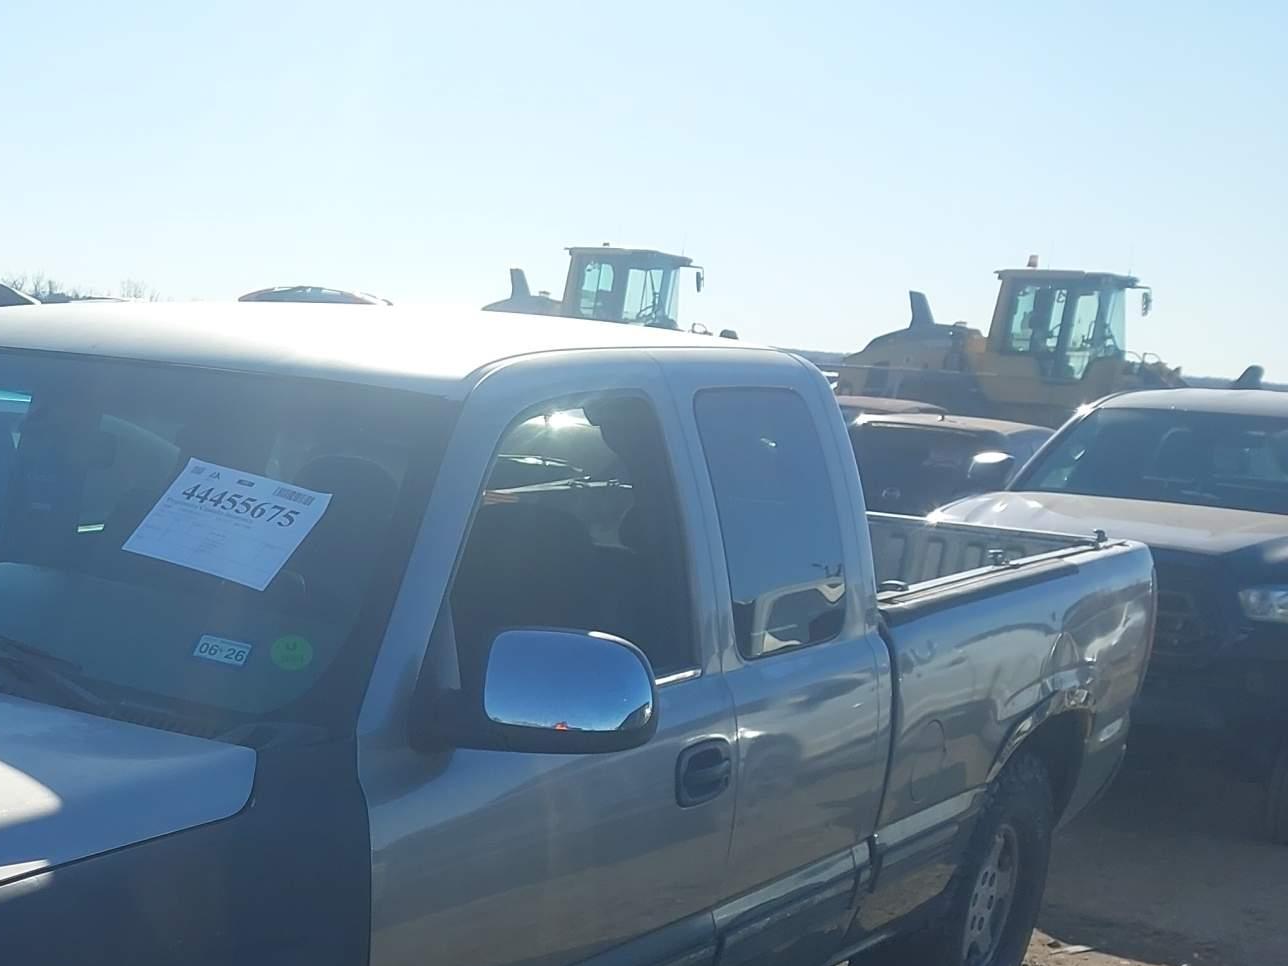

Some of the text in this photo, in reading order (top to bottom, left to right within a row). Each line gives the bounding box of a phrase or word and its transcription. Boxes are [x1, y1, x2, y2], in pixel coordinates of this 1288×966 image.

[182, 484, 300, 527] 44455675
[199, 642, 245, 662] 06 26
